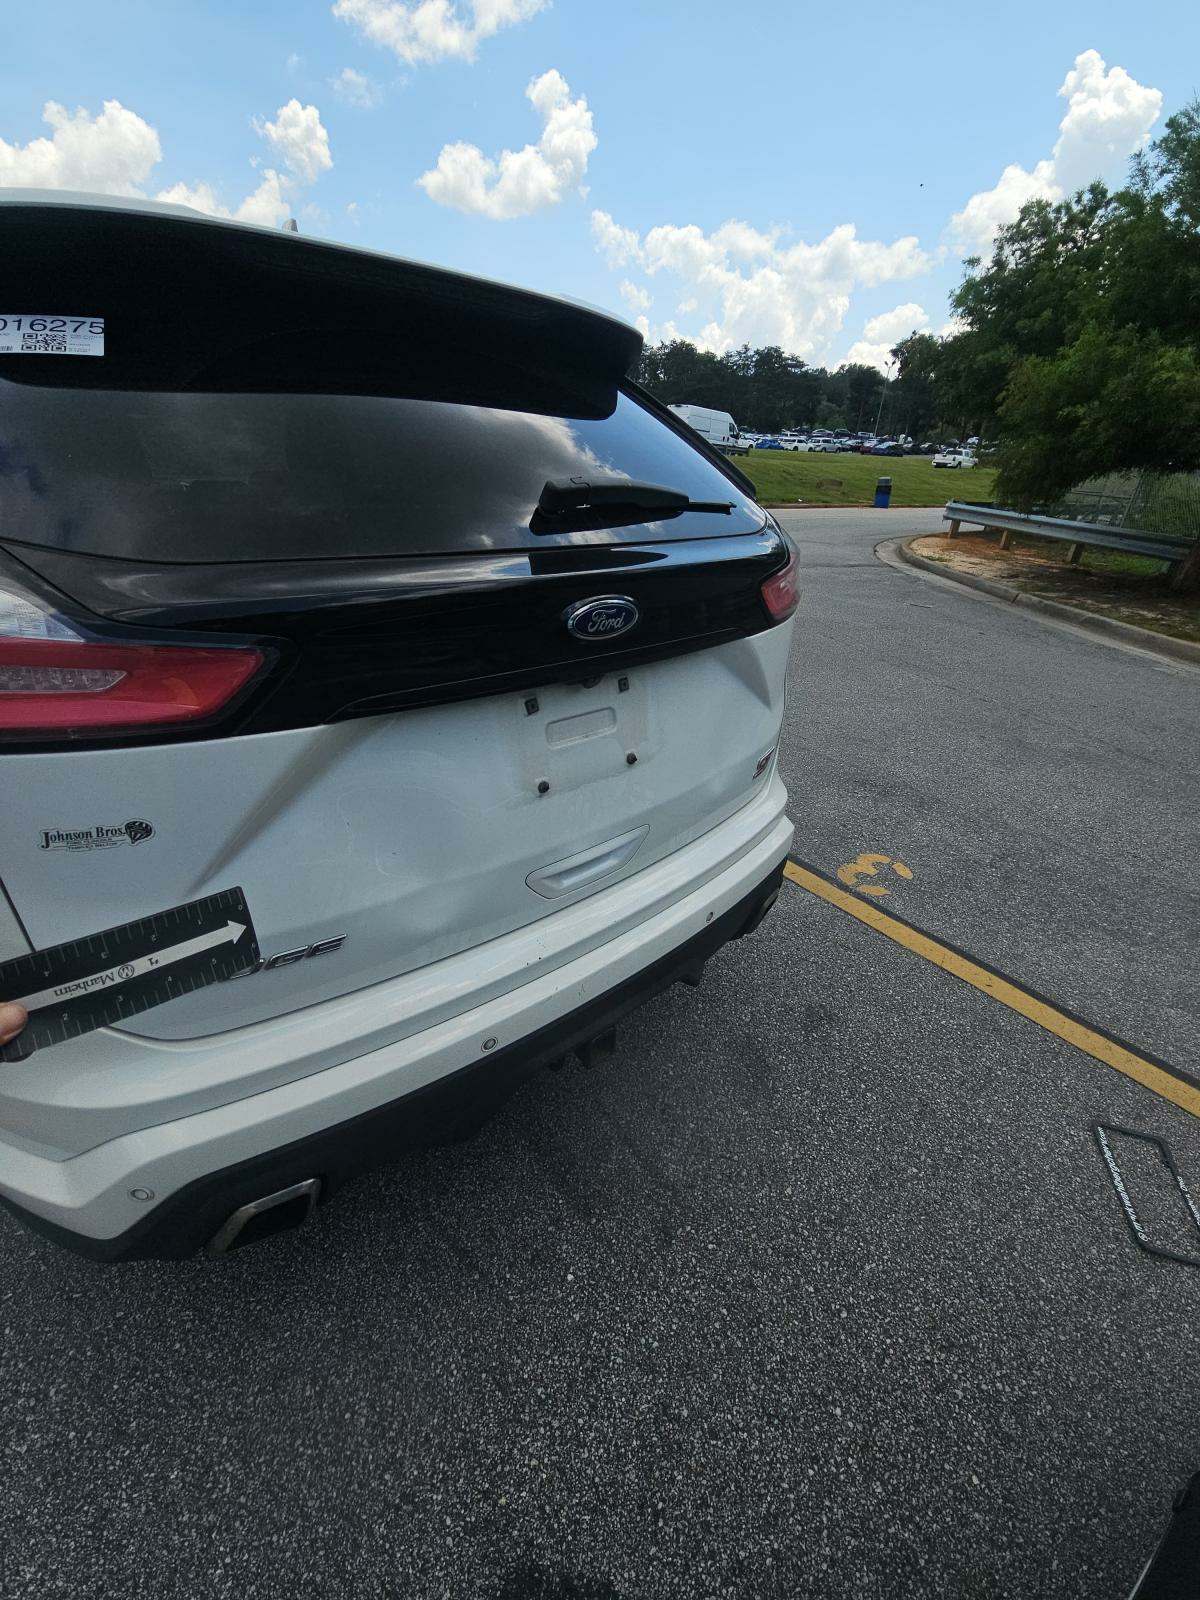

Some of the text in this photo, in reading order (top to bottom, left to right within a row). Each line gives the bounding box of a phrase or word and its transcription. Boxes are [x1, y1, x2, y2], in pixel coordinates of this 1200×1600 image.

[588, 608, 626, 633] Ford
[41, 830, 94, 849] Johnson
[95, 826, 126, 839] Bros.
[53, 971, 116, 997] Manheim
